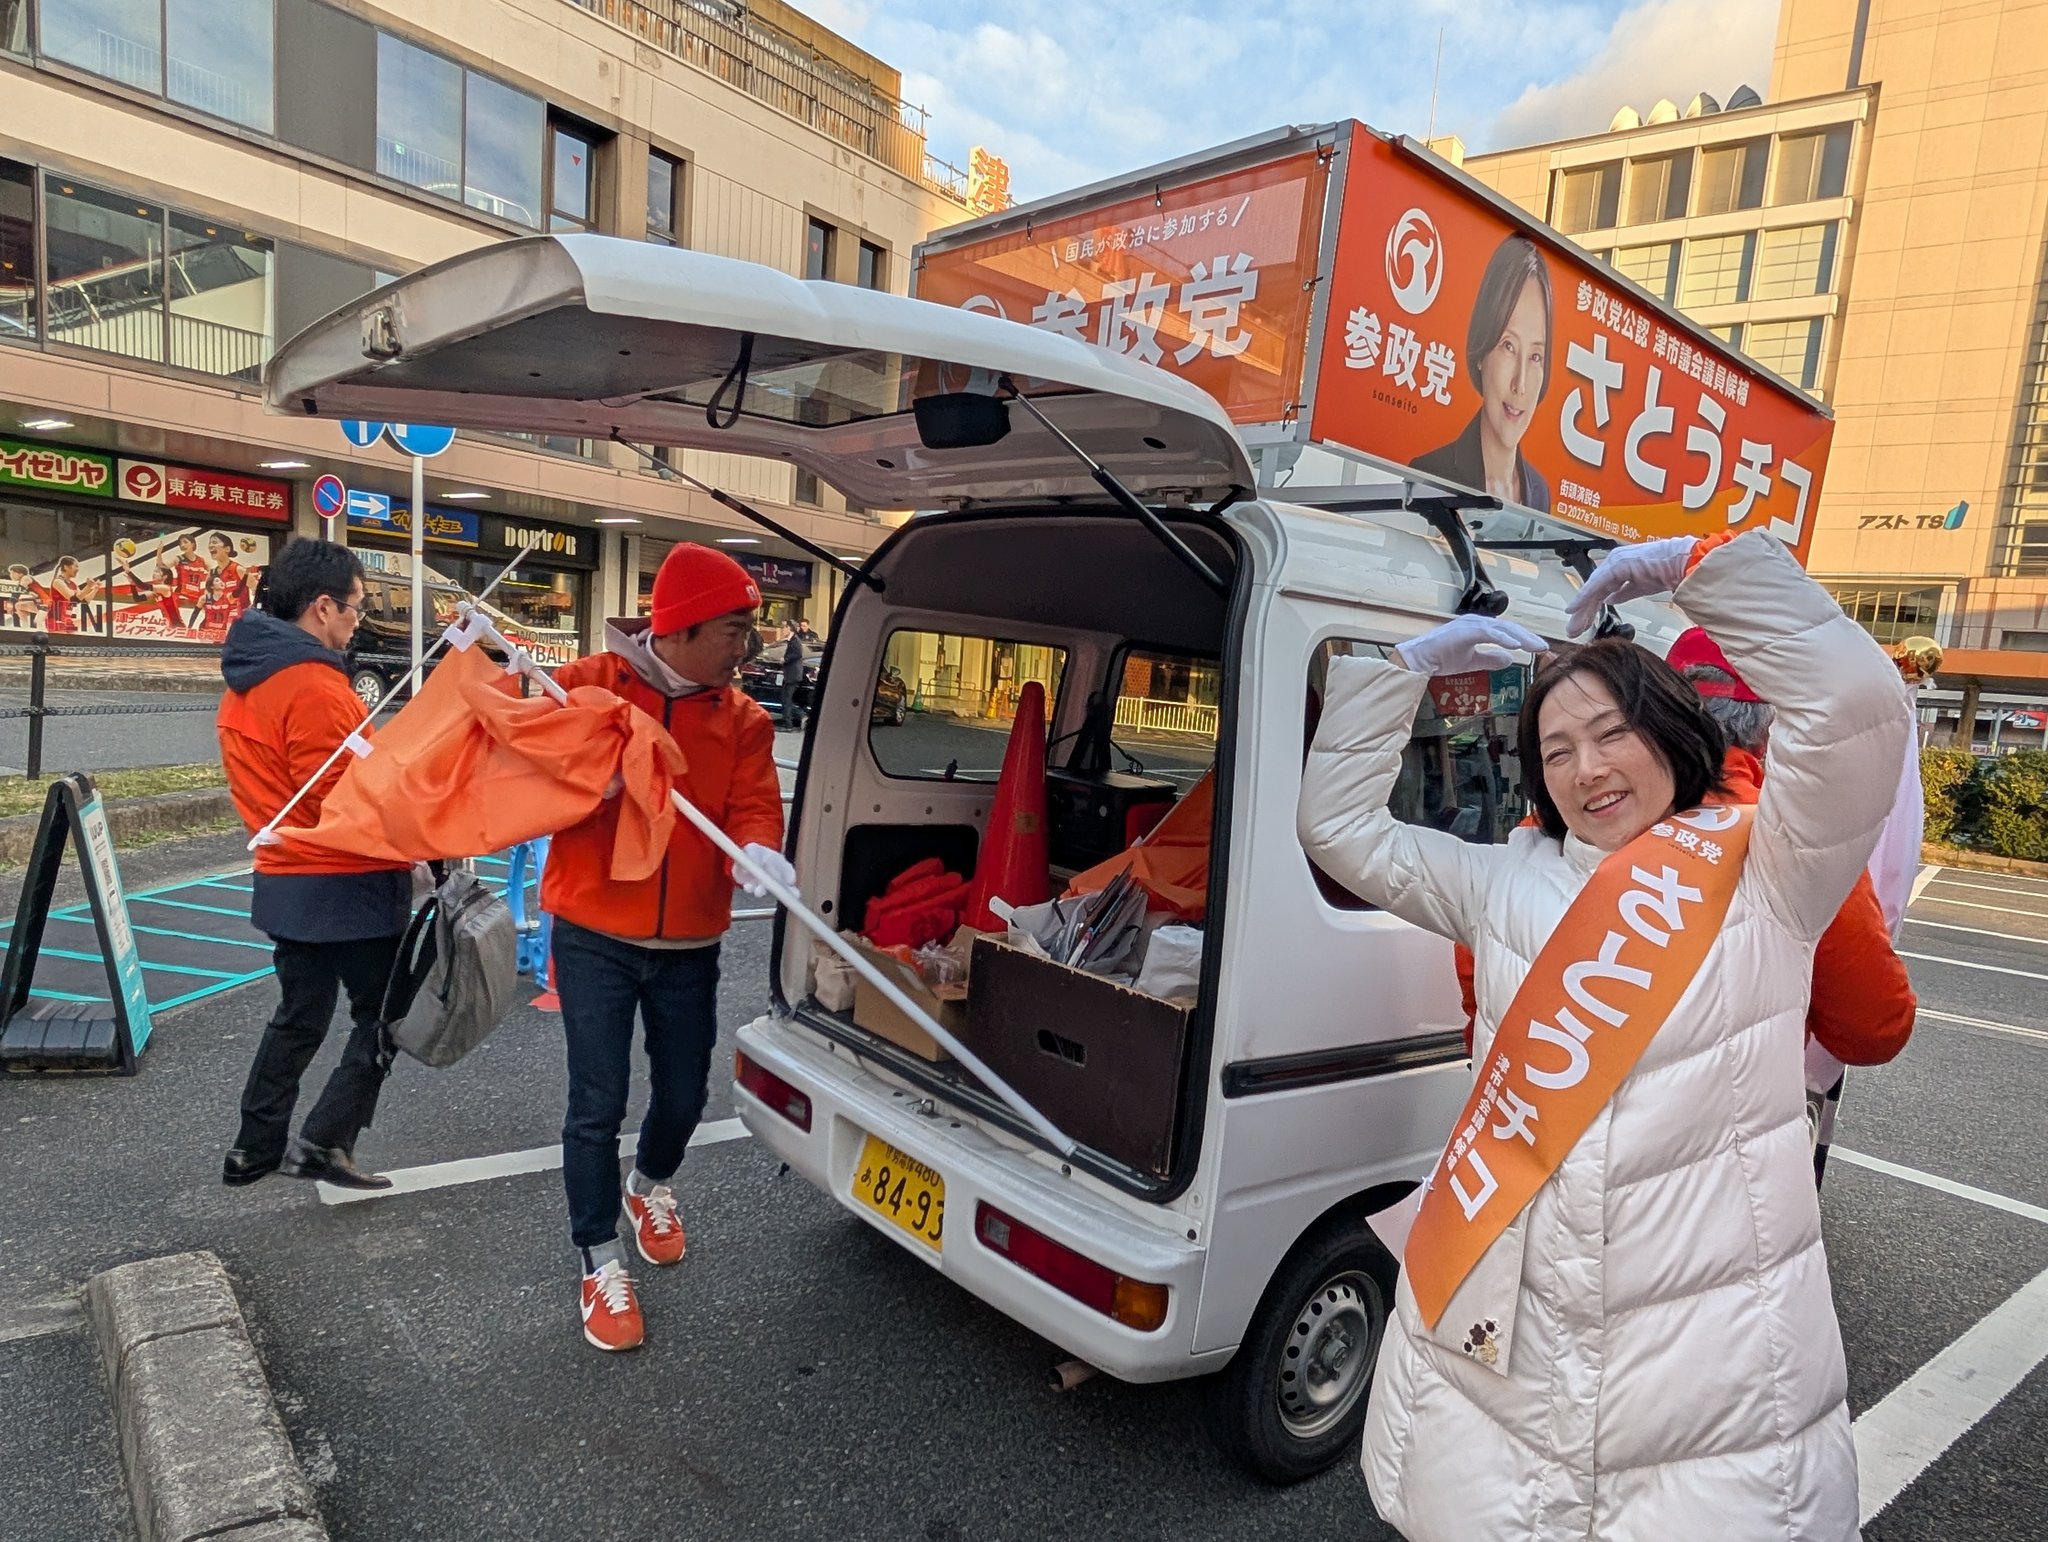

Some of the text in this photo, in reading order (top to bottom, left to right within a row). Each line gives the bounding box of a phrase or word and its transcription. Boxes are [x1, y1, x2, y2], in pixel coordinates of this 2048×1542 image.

[1344, 306, 1456, 406] 参政党
[1575, 280, 1750, 407] 参政党公認 津市議会議員候補
[1371, 388, 1418, 415] sanseito
[1560, 334, 1813, 546] さとうチコ
[0, 448, 107, 488] イゼリヤ
[167, 477, 284, 512] 東海東京証券
[1560, 479, 1600, 508] 街頭演説会
[1858, 514, 1944, 529] アスト TS
[1651, 823, 1723, 865] 参政党
[1449, 865, 1704, 1222] さとうチコ
